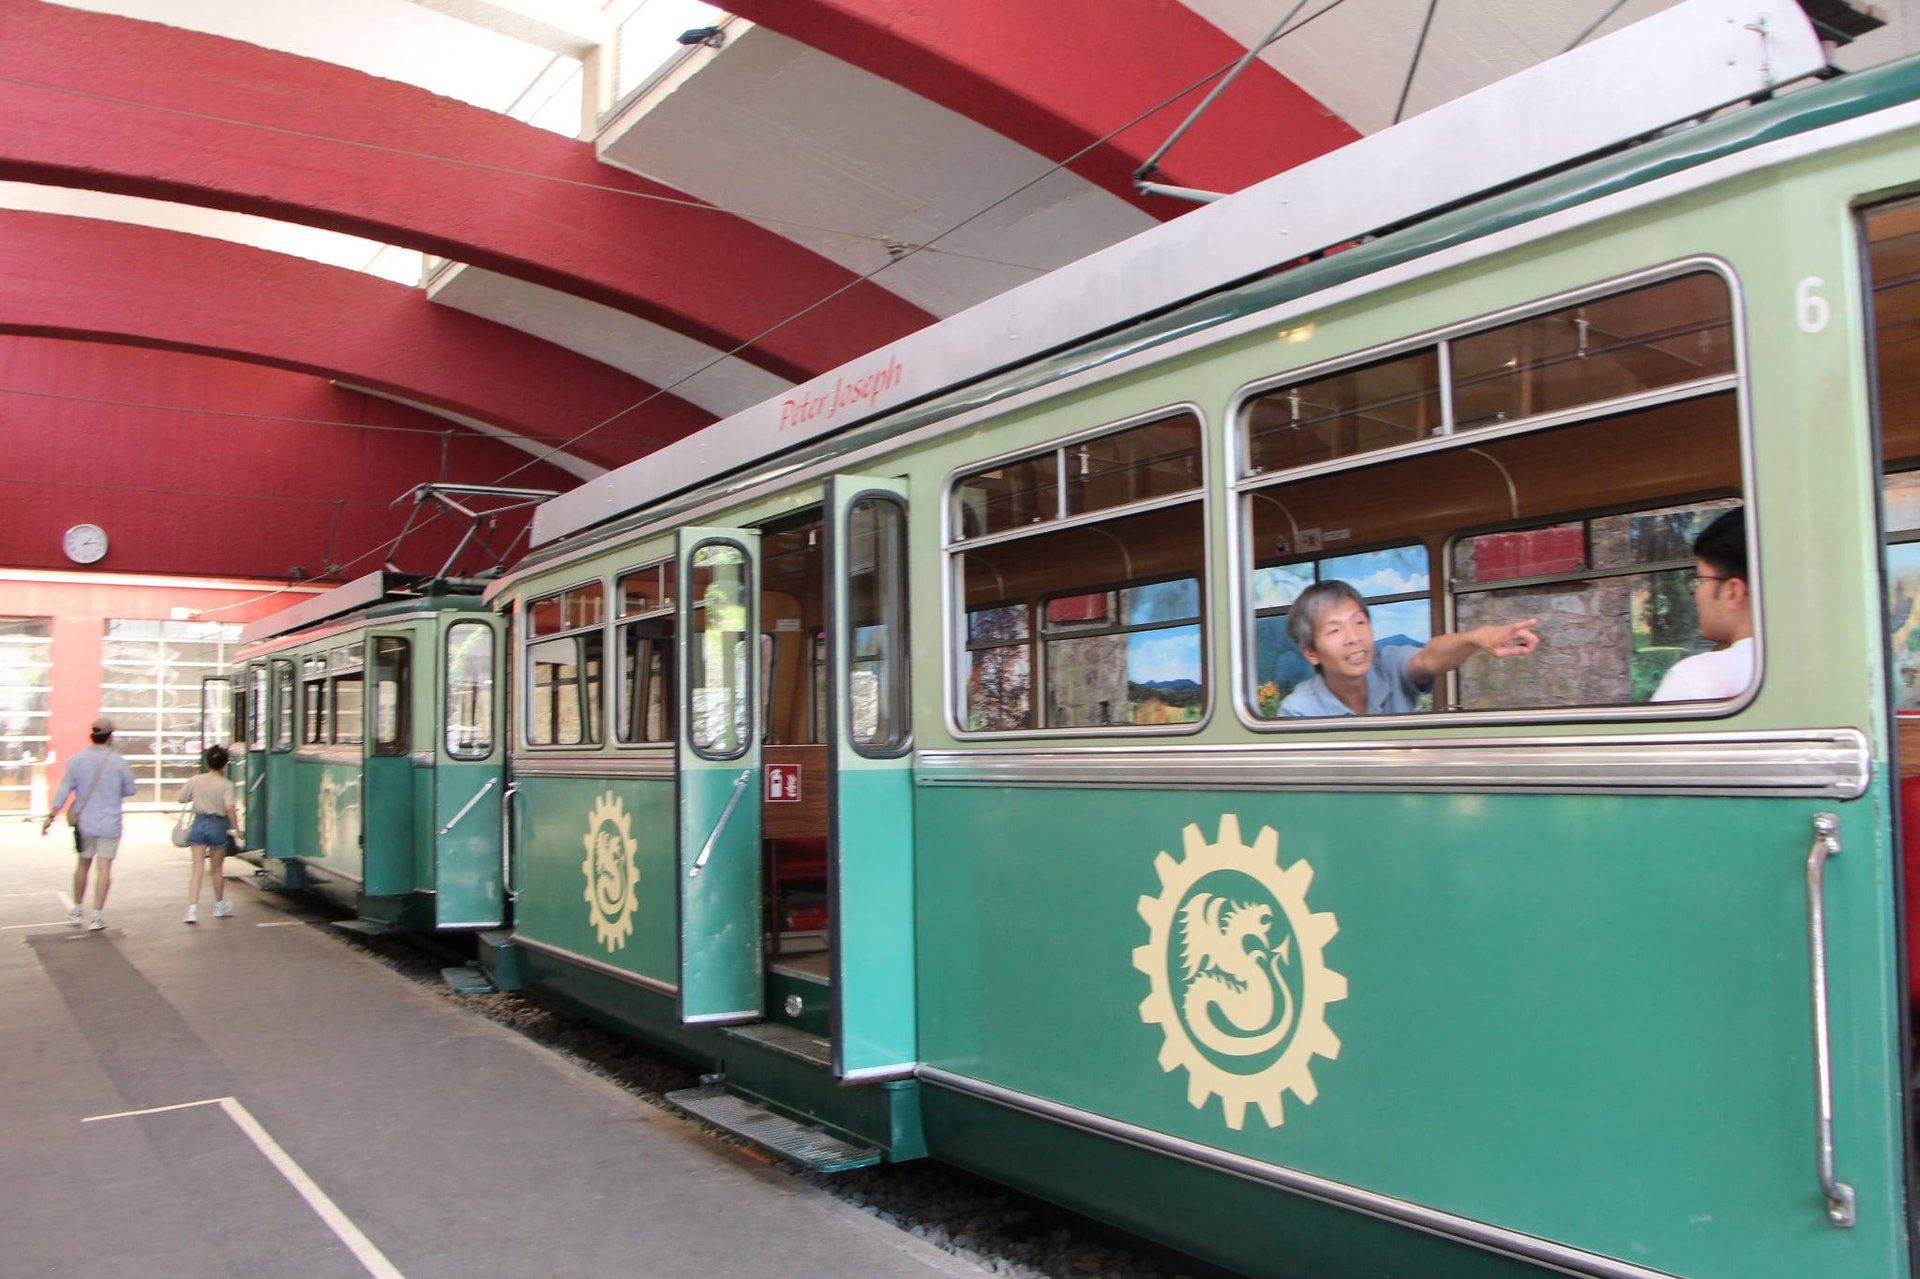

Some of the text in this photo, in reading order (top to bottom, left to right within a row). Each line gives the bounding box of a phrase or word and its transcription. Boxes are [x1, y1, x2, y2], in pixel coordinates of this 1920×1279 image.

[1796, 275, 1829, 334] 6
[779, 353, 903, 432] Peter Joseph
